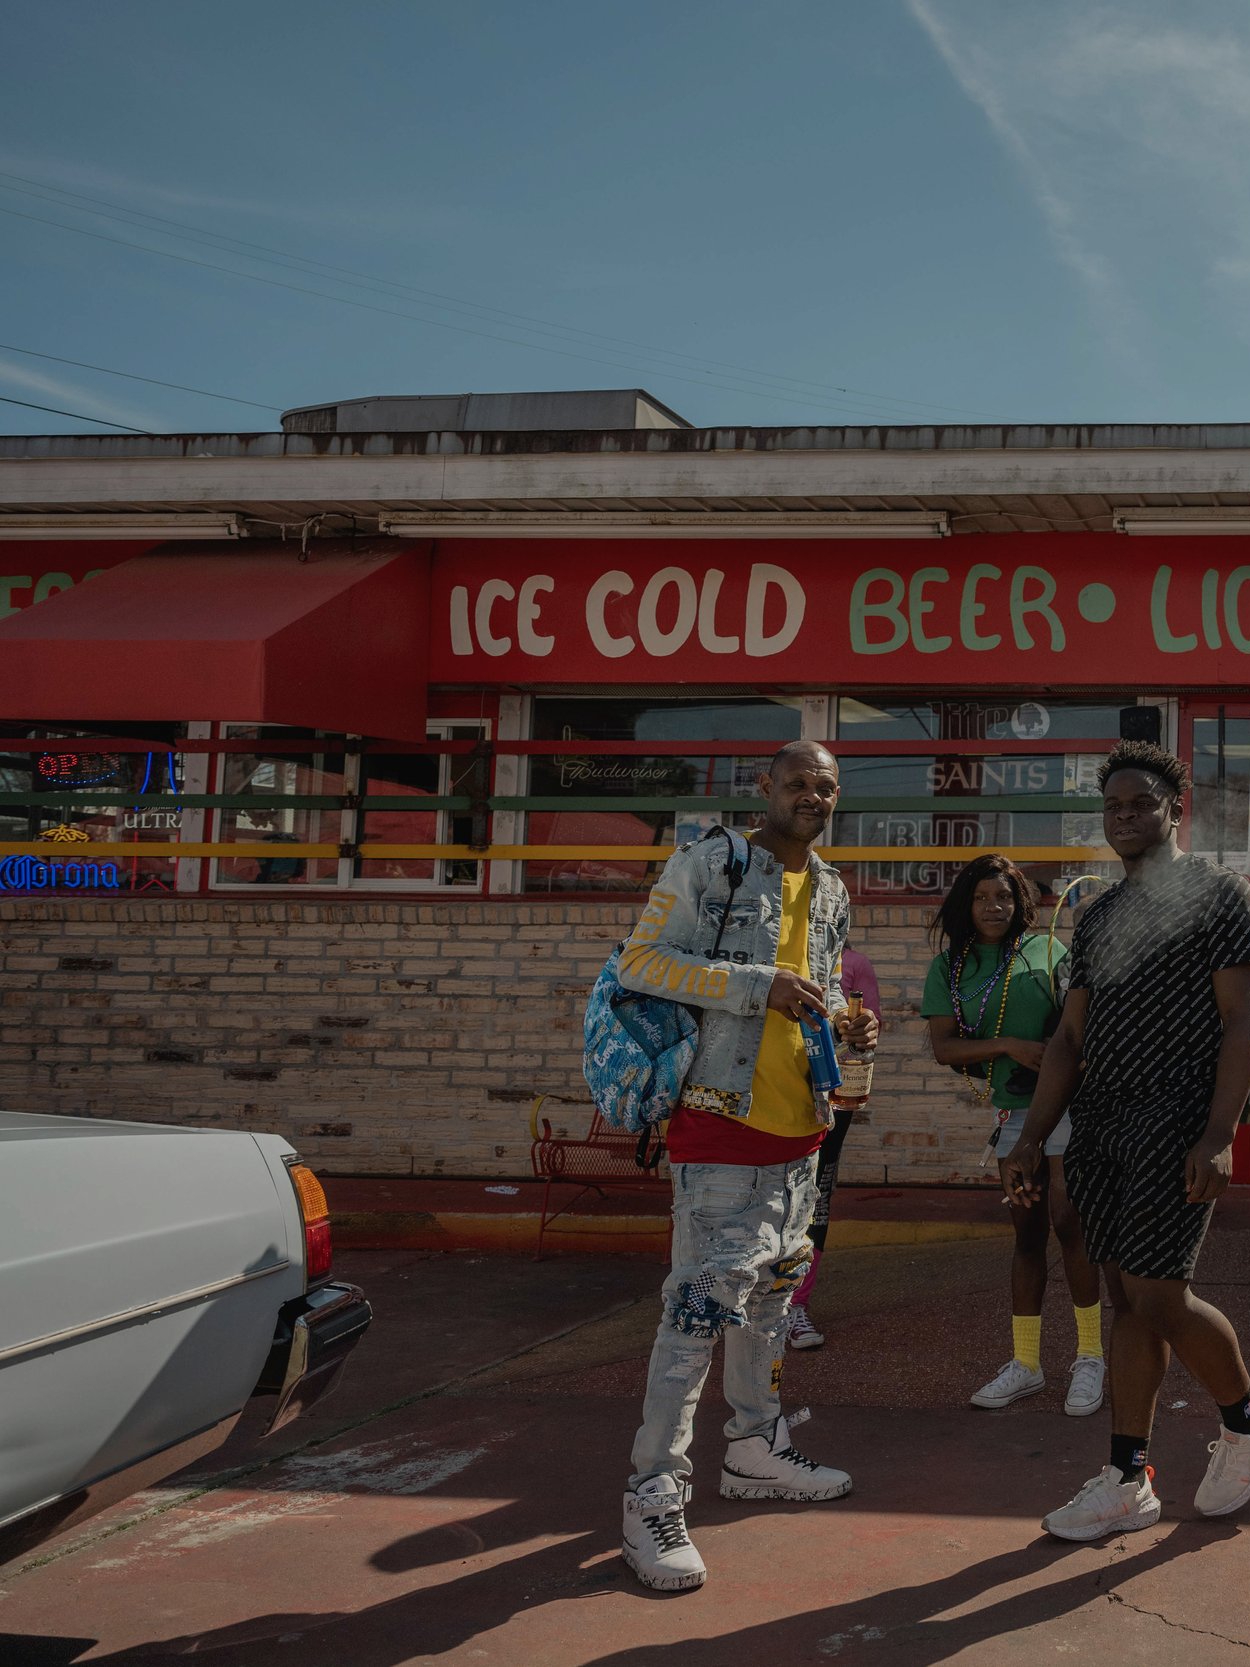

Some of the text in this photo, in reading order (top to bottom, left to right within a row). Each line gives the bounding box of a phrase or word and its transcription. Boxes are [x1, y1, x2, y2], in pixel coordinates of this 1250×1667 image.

[449, 574, 556, 657] ICE
[585, 563, 807, 658] COLD
[849, 563, 1066, 655] BEER
[37, 752, 121, 776] OPEN
[565, 760, 673, 779] Budweiser
[926, 760, 1049, 791] SAINTS
[124, 813, 182, 829] ULTR
[886, 818, 986, 846] BUD
[0, 855, 120, 890] Corona
[865, 861, 957, 891] LIG
